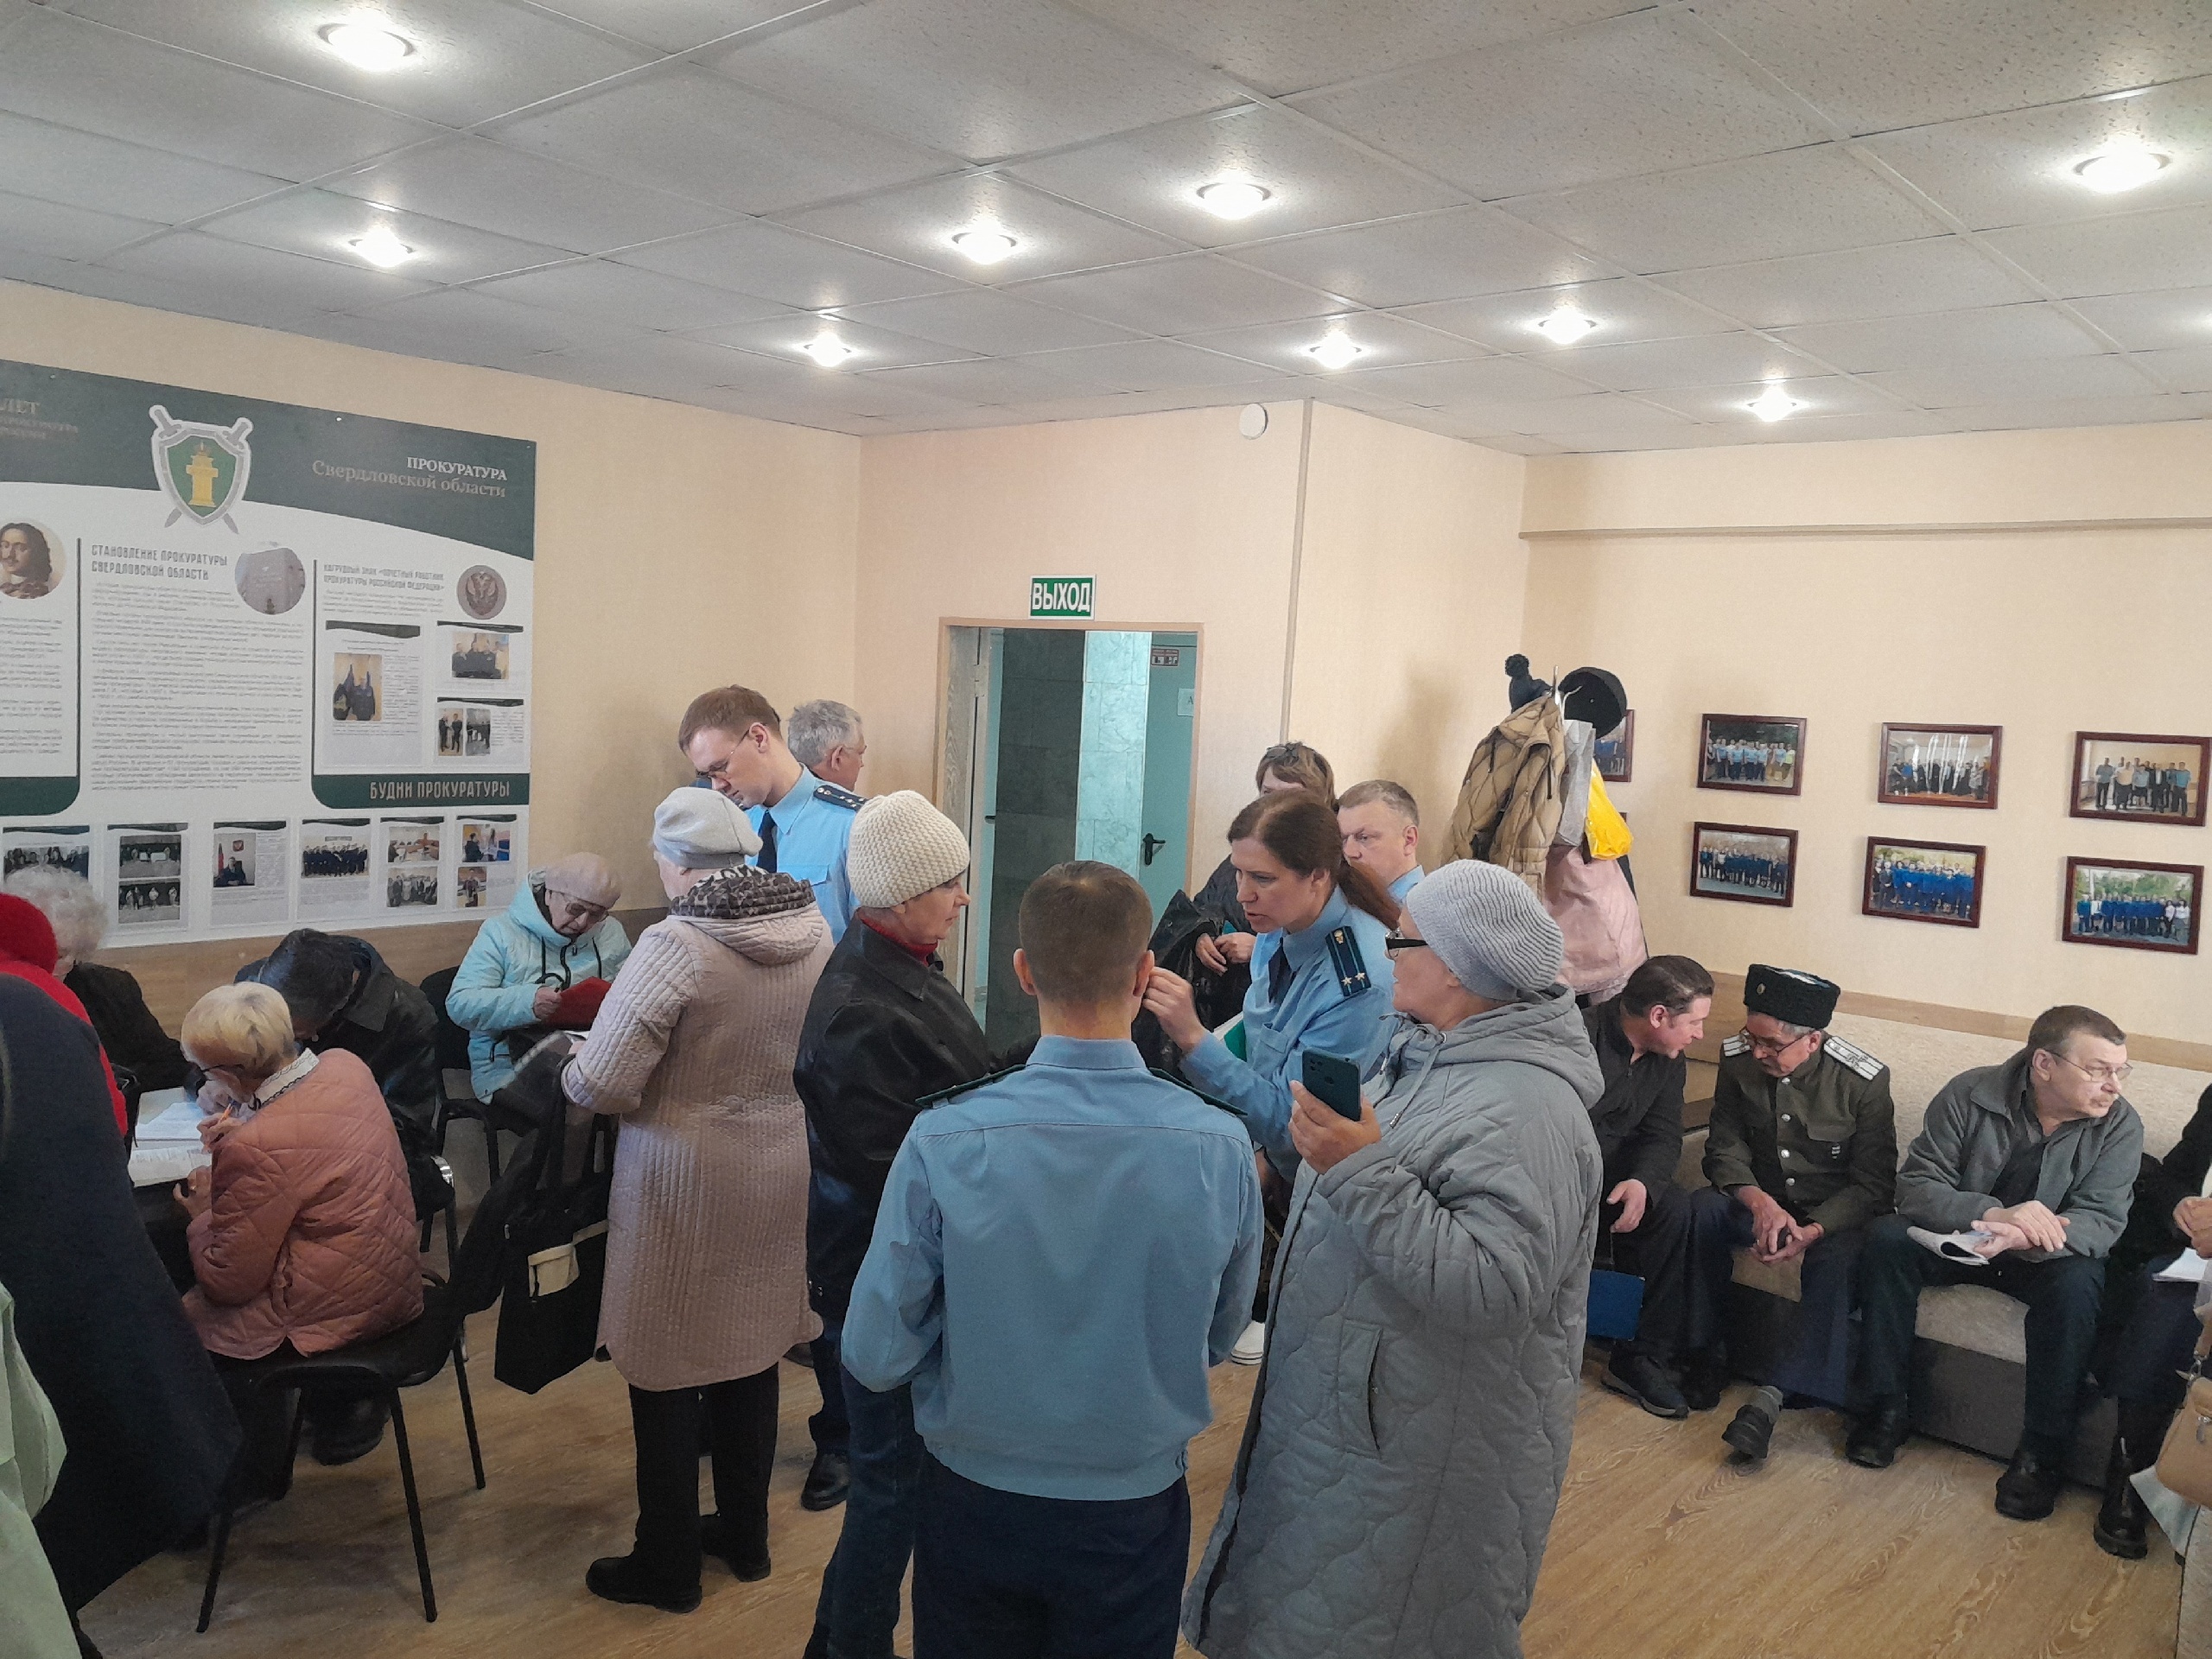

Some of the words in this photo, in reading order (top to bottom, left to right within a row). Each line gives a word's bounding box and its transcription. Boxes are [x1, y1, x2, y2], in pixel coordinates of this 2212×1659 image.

[312, 460, 436, 490] Свердловской
[440, 477, 506, 498] области
[406, 456, 508, 481] ПРОКУРАТУРА
[91, 544, 157, 561] СТАНОВЛЕНИЕ
[160, 550, 227, 566] ПРОКУРАТУРЫ
[91, 561, 164, 577] СВЕРДЛОВСКОЙ
[167, 566, 209, 581] ОБЛАСТИ
[1032, 582, 1090, 613] ВЫХОД
[370, 781, 413, 801] БУДНИ
[417, 780, 511, 799] ПРОКУРАТУРЫ
